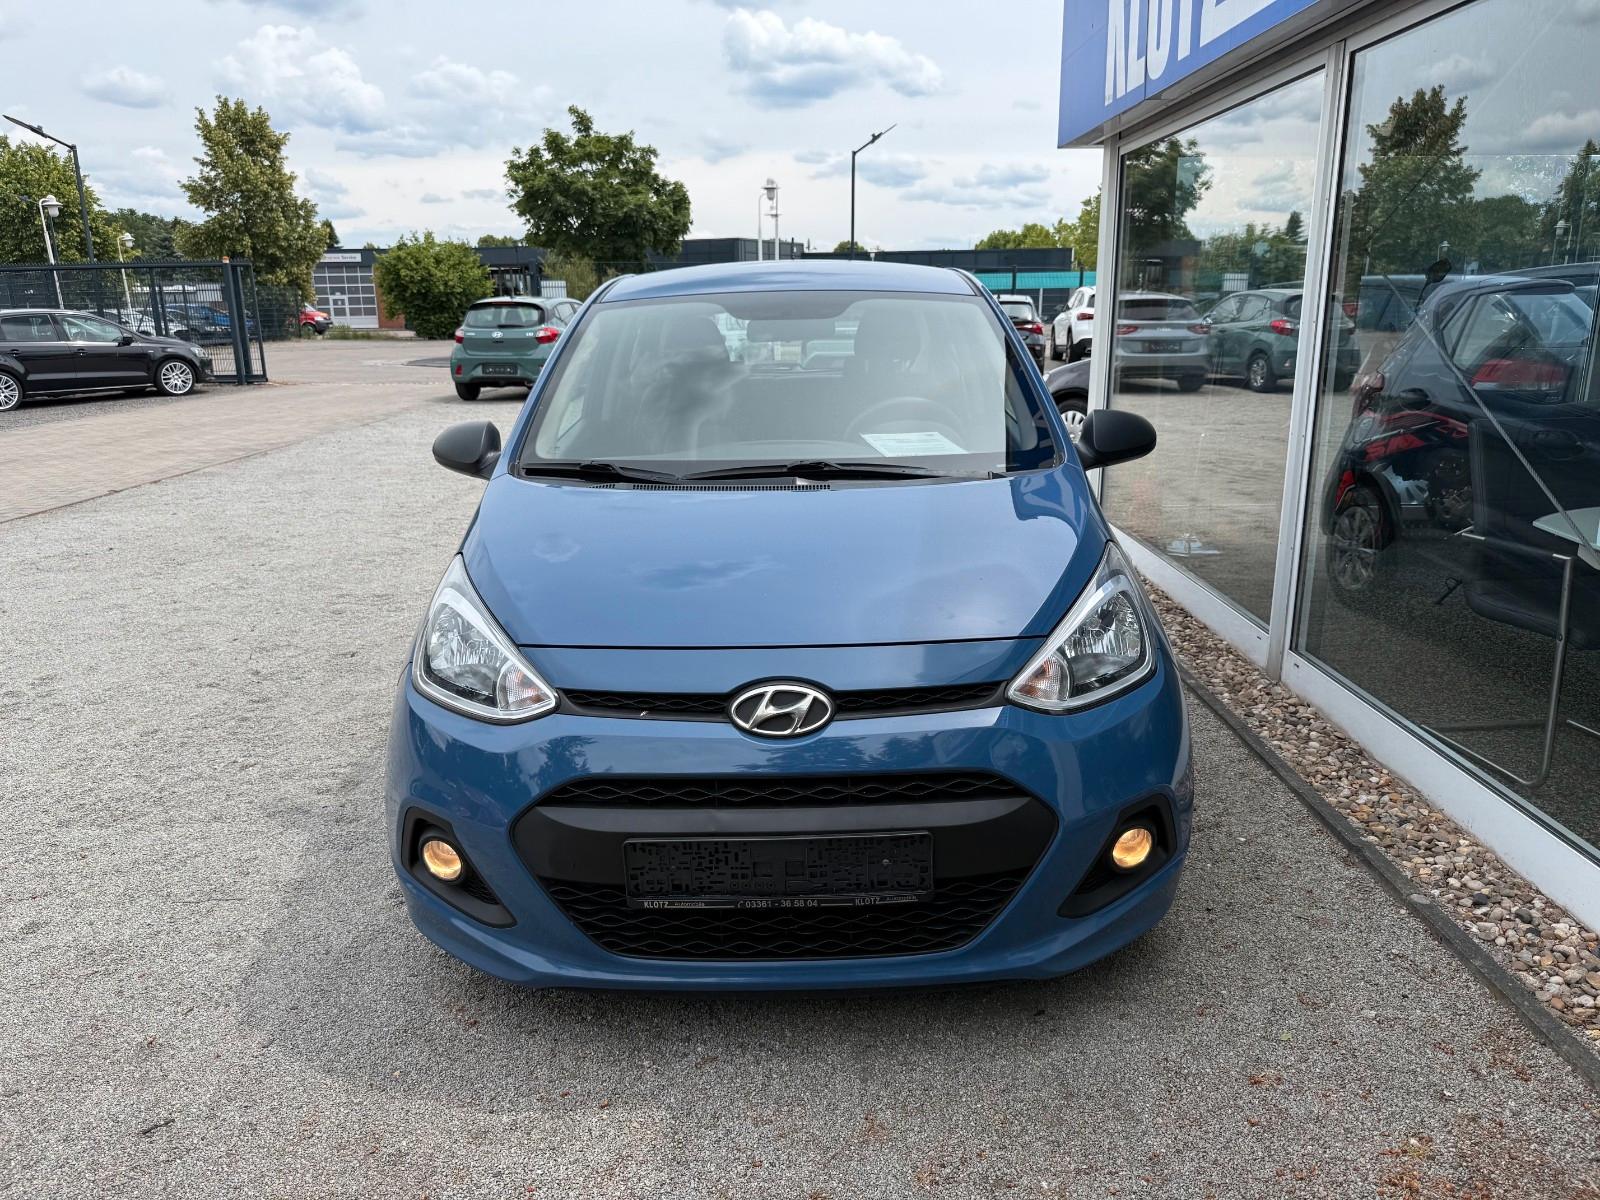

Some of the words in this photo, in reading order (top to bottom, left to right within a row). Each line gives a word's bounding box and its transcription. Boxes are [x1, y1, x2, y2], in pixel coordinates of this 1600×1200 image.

[644, 901, 669, 909] KLOTZ
[745, 900, 772, 908] 03361
[780, 899, 791, 907] 36
[807, 899, 819, 907] 04
[855, 897, 881, 906] KLOTZ
